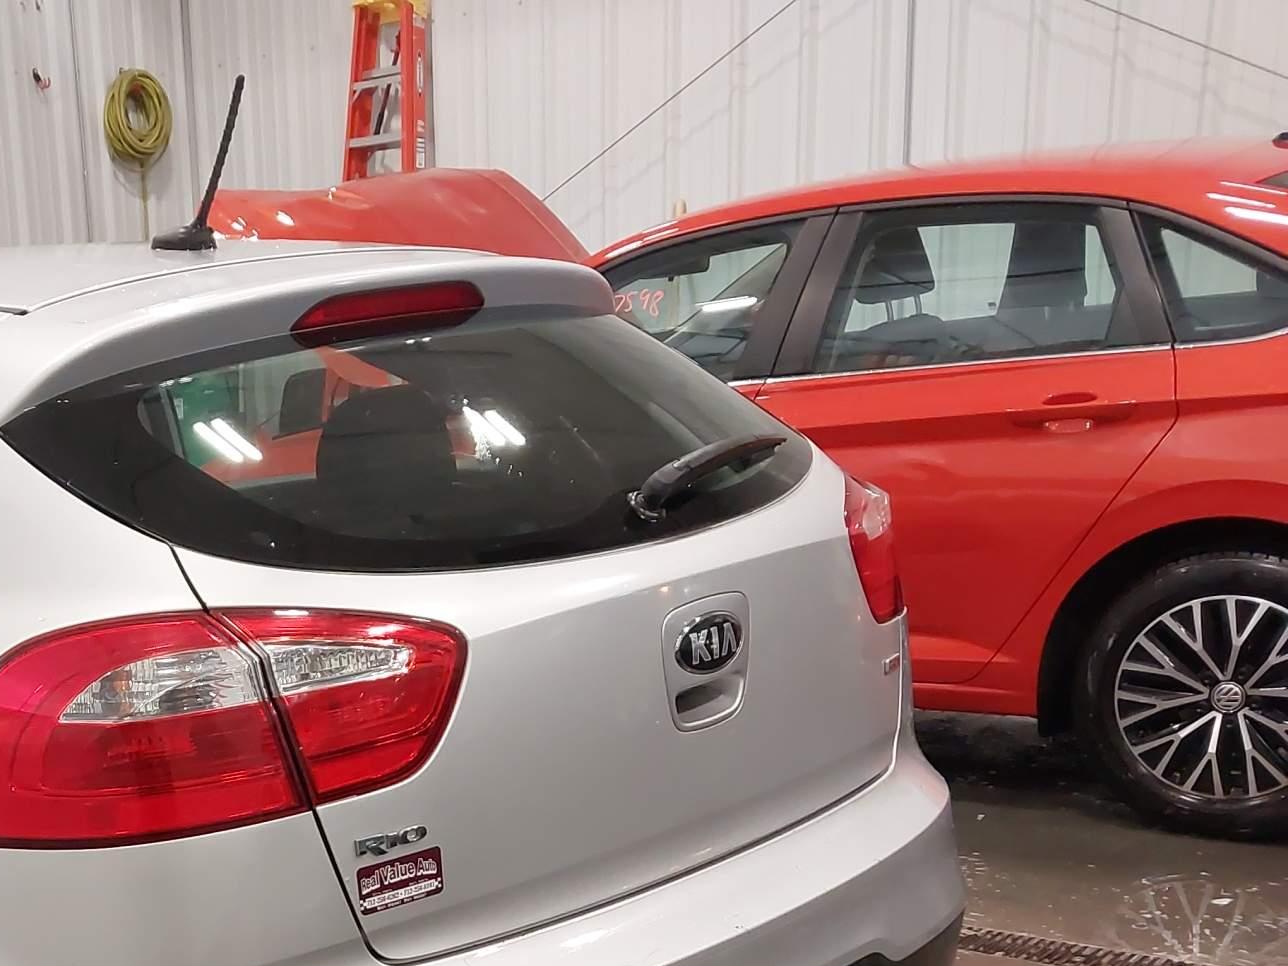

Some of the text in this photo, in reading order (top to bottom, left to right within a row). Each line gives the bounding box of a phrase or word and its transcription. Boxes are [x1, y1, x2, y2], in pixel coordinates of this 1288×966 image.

[689, 622, 737, 665] KIA
[360, 869, 381, 895] Real
[380, 863, 416, 885] Value
[417, 858, 438, 876] Auto
